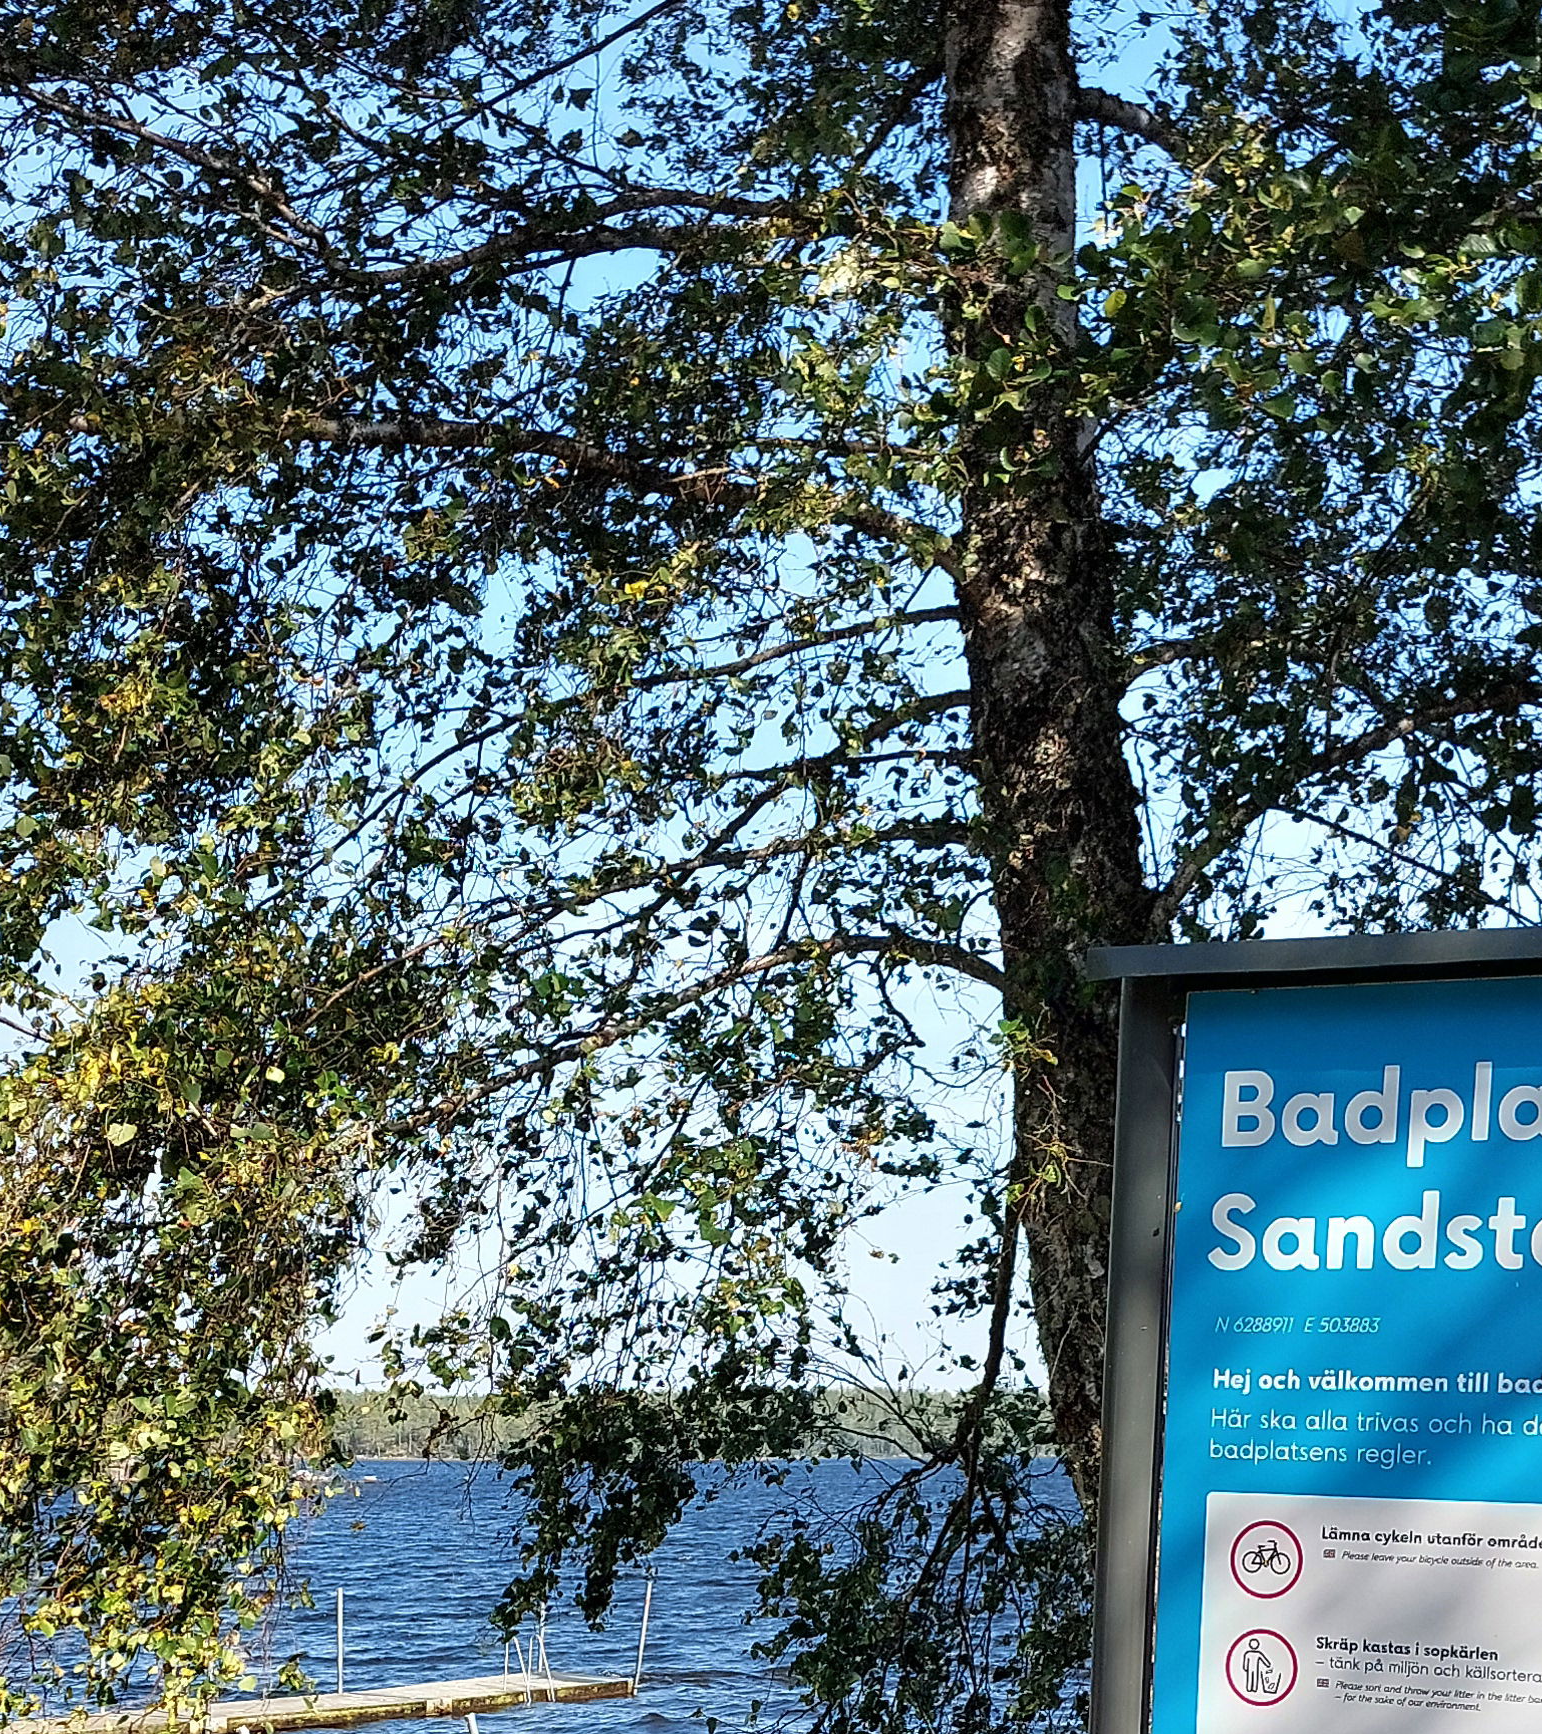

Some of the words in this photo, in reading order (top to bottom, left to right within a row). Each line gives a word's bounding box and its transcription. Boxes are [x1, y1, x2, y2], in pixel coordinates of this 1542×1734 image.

[1303, 1316, 1315, 1332] E
[1317, 1316, 1380, 1332] 503883
[1213, 1367, 1251, 1394] Hej
[1258, 1368, 1300, 1389] och
[1307, 1369, 1448, 1391] välkommen
[1456, 1371, 1489, 1392] till
[1211, 1407, 1251, 1428] Här
[1260, 1408, 1296, 1429] ska
[1305, 1408, 1348, 1431] alla
[1356, 1411, 1418, 1432] trivas
[1428, 1412, 1471, 1433] och
[1481, 1413, 1513, 1435] ha
[1209, 1437, 1347, 1465] badplatsens
[1357, 1442, 1430, 1469] regler.
[1321, 1525, 1370, 1541] Lämna
[1374, 1528, 1422, 1546] cykeln
[1427, 1532, 1483, 1546] utanför
[1316, 1636, 1358, 1655] Skräp
[1362, 1638, 1411, 1655] kastas
[1423, 1644, 1498, 1661] sopkärlen
[1329, 1656, 1361, 1670] tänk
[1363, 1657, 1384, 1674] på
[1388, 1659, 1429, 1678] miljön
[1433, 1663, 1460, 1677] och
[1464, 1664, 1542, 1682] källsortera
